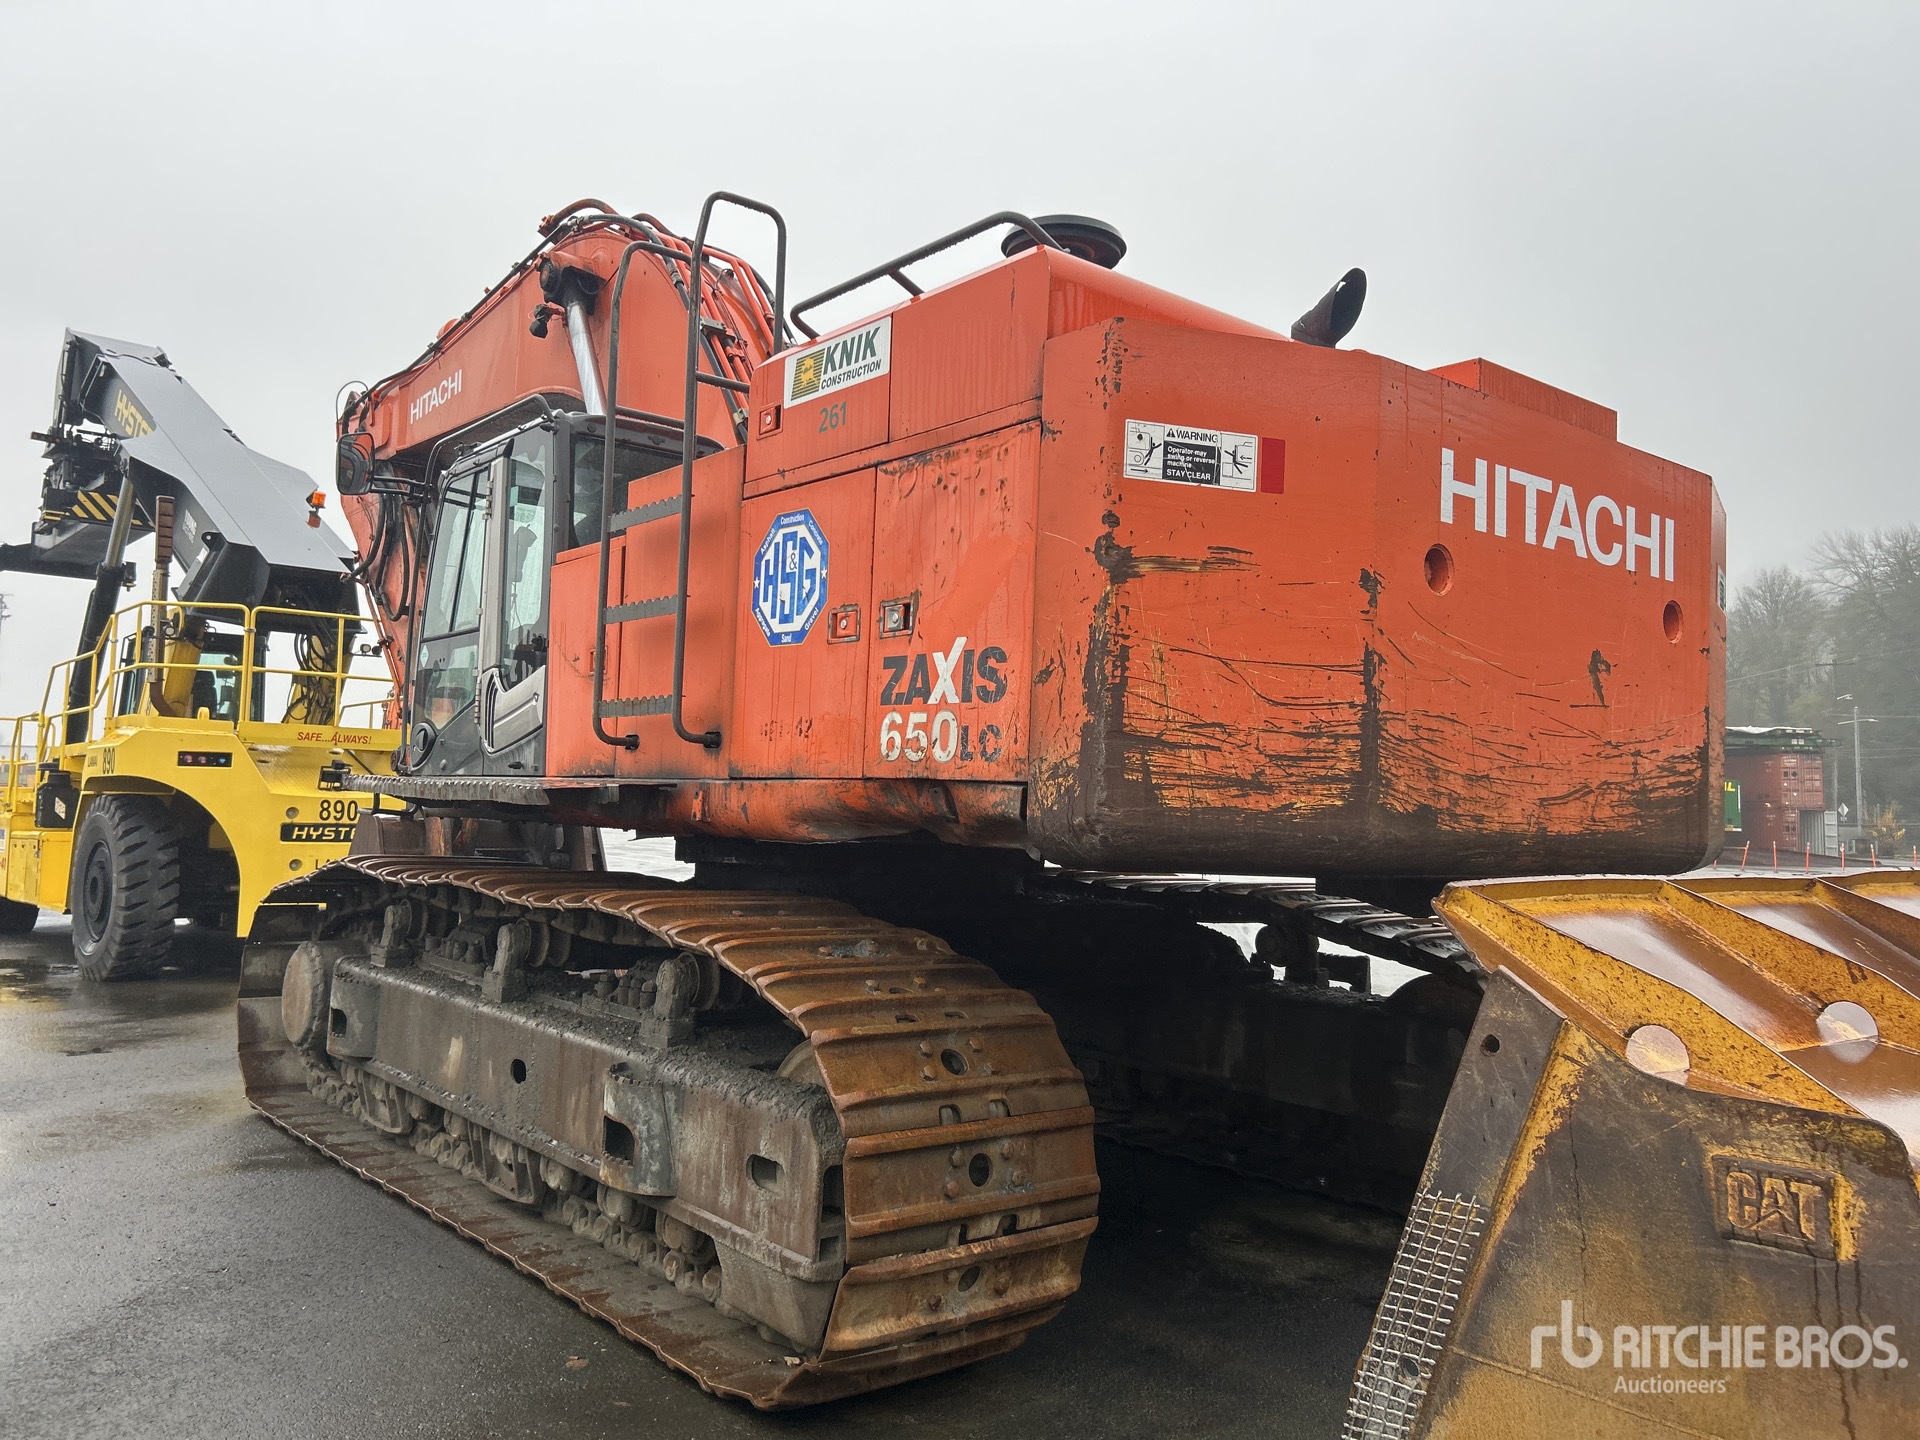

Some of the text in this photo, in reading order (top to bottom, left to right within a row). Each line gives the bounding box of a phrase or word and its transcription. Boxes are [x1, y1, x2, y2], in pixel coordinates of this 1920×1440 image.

[823, 326, 881, 375] KNIK
[821, 359, 881, 390] CONSTRUCTION
[409, 368, 463, 425] HITACHI
[819, 401, 847, 433] 261
[1176, 430, 1218, 443] WARNING
[1167, 446, 1207, 458] Operator may
[1166, 469, 1211, 480] STAY CLEAR
[780, 513, 805, 525] Construction
[1440, 447, 1675, 582] HITACHI
[760, 528, 776, 556] Asphalt
[808, 520, 823, 546] Concrete
[804, 606, 819, 631] Gravel
[781, 633, 792, 643] Sand
[880, 636, 1008, 705] ZAXIS
[102, 747, 116, 775] 890
[319, 799, 359, 821] 890
[1725, 1171, 1824, 1243] CAT
